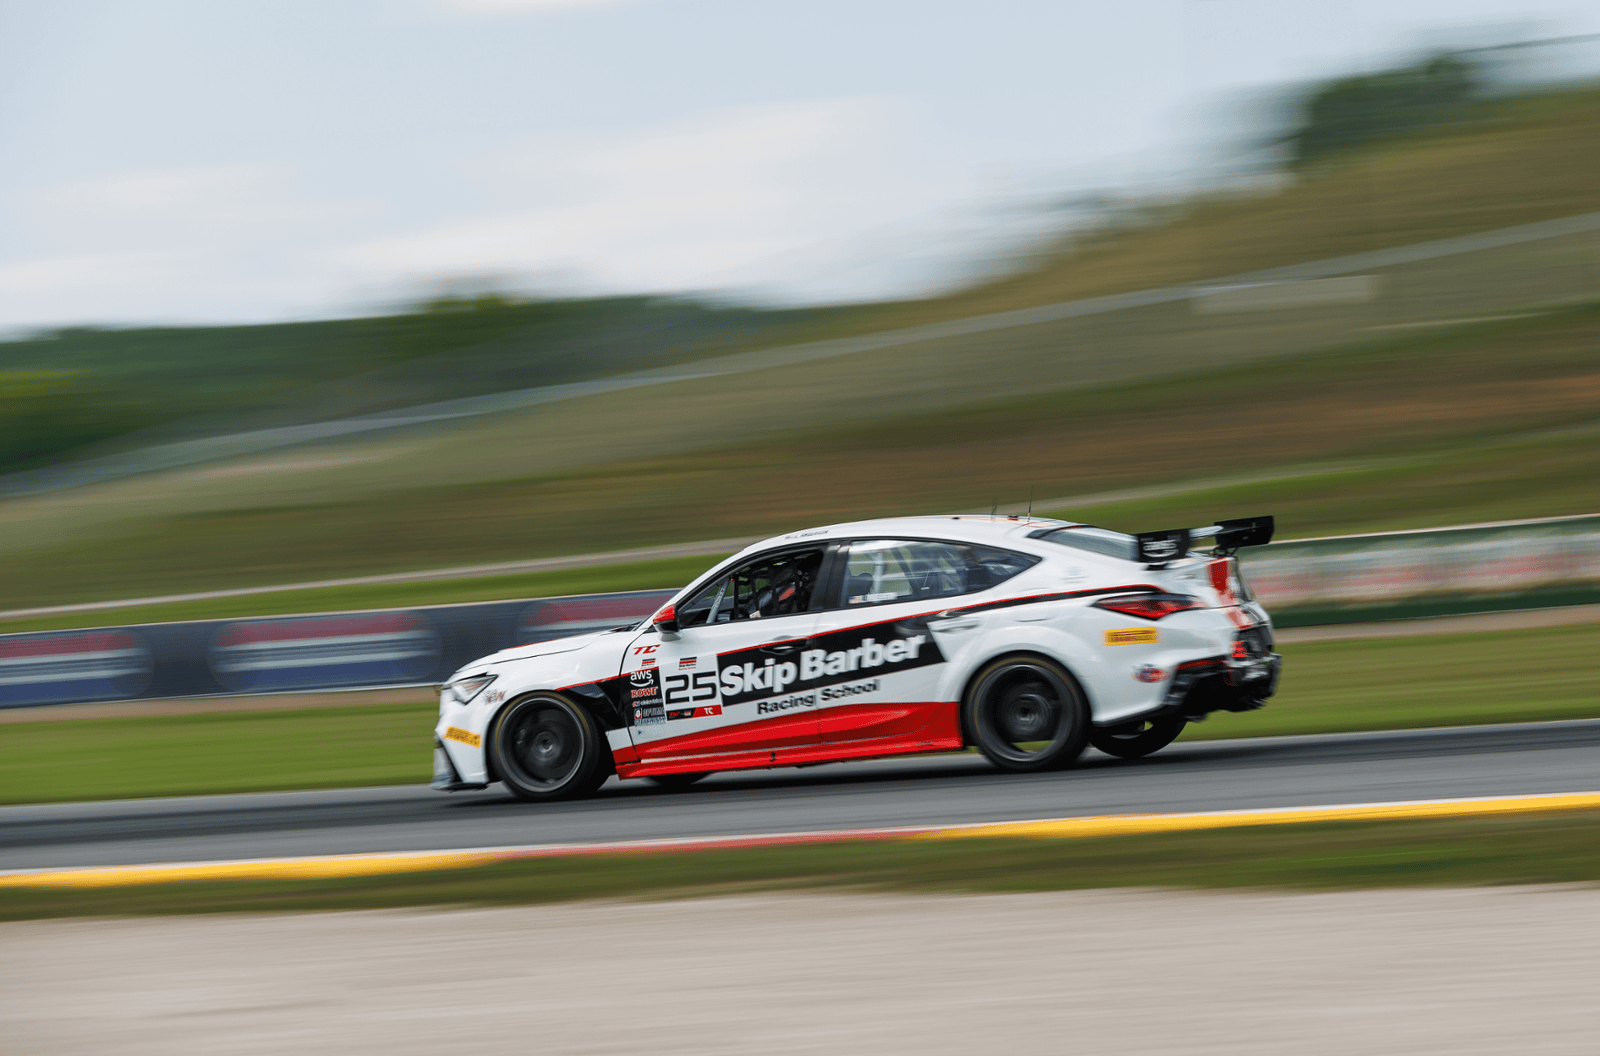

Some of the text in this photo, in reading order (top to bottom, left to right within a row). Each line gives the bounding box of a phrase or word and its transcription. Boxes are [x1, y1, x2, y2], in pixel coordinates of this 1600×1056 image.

[633, 644, 661, 655] TC
[630, 669, 652, 681] aws
[720, 635, 926, 697] Skip Barber
[631, 687, 657, 698] ROWE
[665, 671, 717, 705] 25
[757, 679, 880, 714] Racing School
